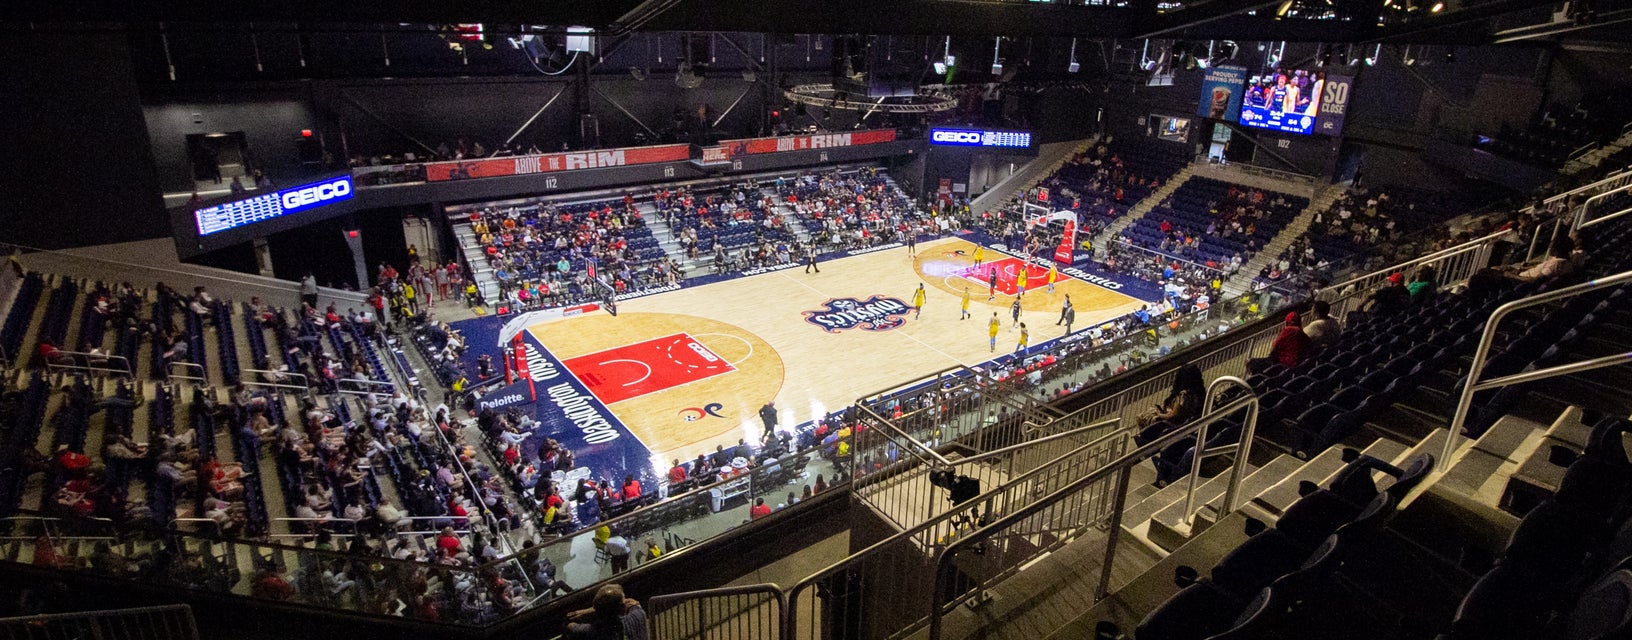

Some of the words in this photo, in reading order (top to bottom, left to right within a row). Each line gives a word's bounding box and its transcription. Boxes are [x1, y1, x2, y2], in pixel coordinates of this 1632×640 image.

[1324, 81, 1348, 104] SO
[1321, 102, 1344, 114] CLOSE
[776, 138, 795, 152] ABOVE
[811, 133, 851, 149] RIM
[933, 131, 980, 143] GEICO
[1278, 139, 1291, 148] 102
[515, 157, 541, 175] ABOVE
[549, 157, 560, 170] THE
[565, 150, 625, 170] RIM
[733, 161, 742, 170] 113
[664, 167, 674, 177] 113
[545, 178, 557, 189] 112
[282, 180, 349, 209] GEICO
[687, 342, 718, 362] GEICO
